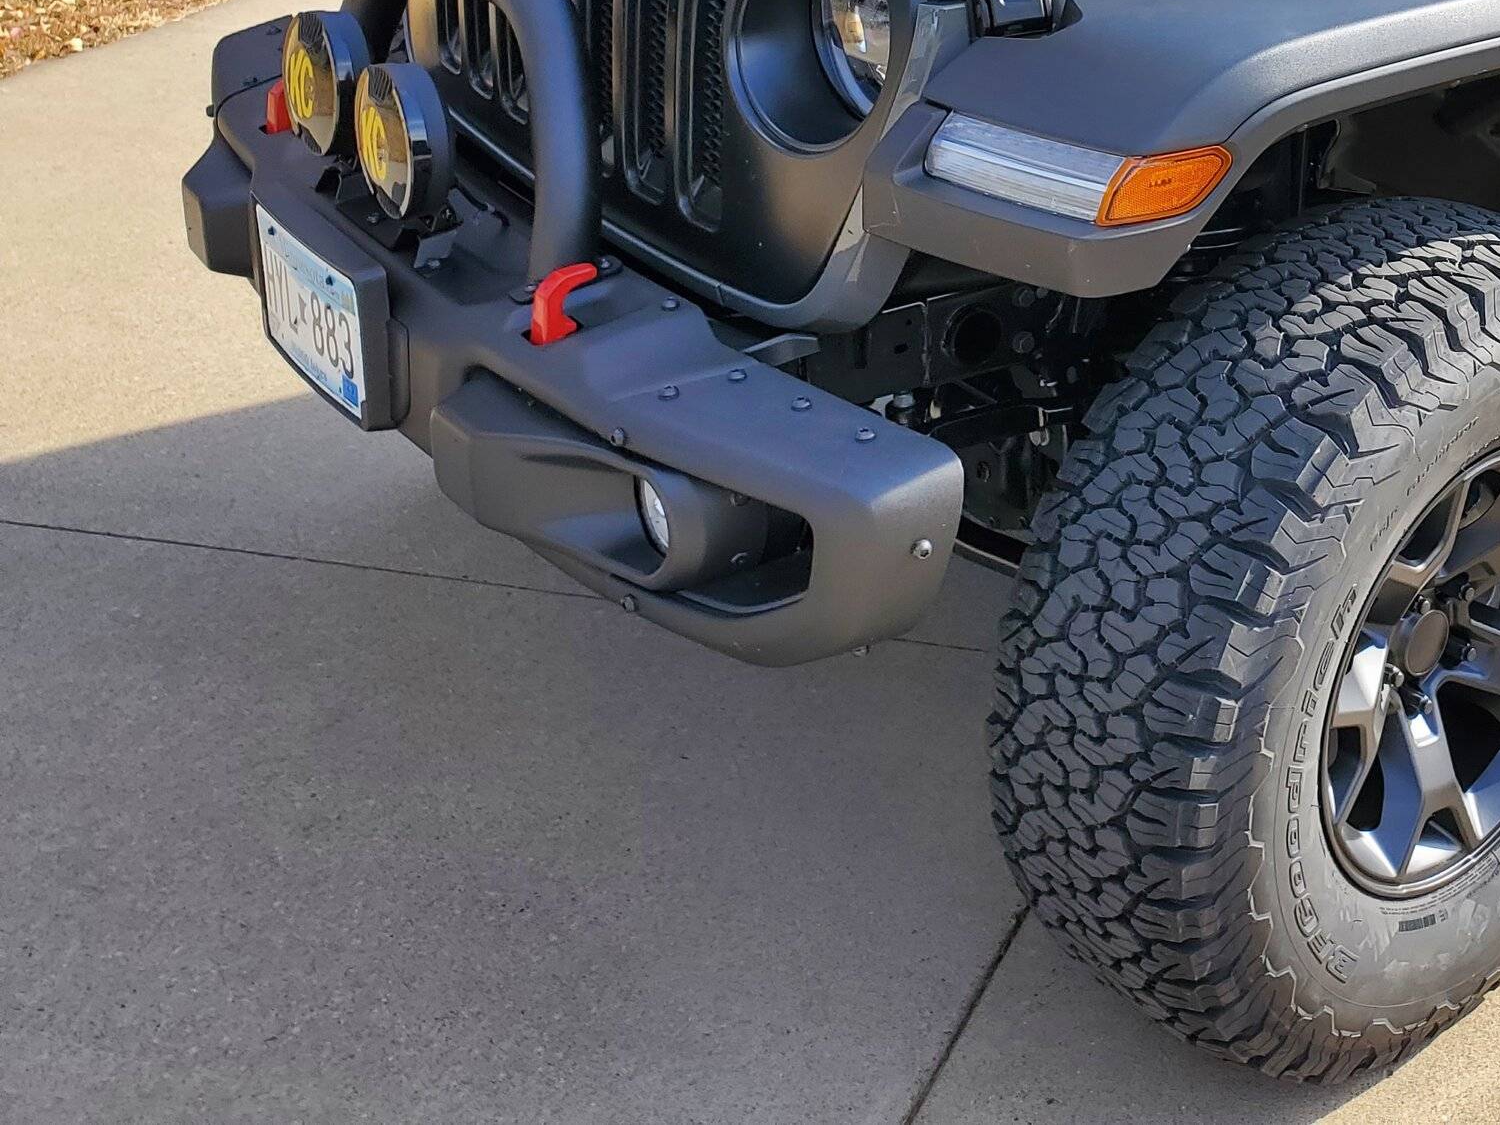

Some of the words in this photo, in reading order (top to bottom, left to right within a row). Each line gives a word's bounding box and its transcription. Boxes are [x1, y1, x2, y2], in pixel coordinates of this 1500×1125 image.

[289, 48, 315, 119] KC
[361, 106, 389, 181] KC
[263, 243, 298, 335] HYL
[310, 291, 354, 380] 883
[1284, 585, 1358, 984] BFGoodrich
